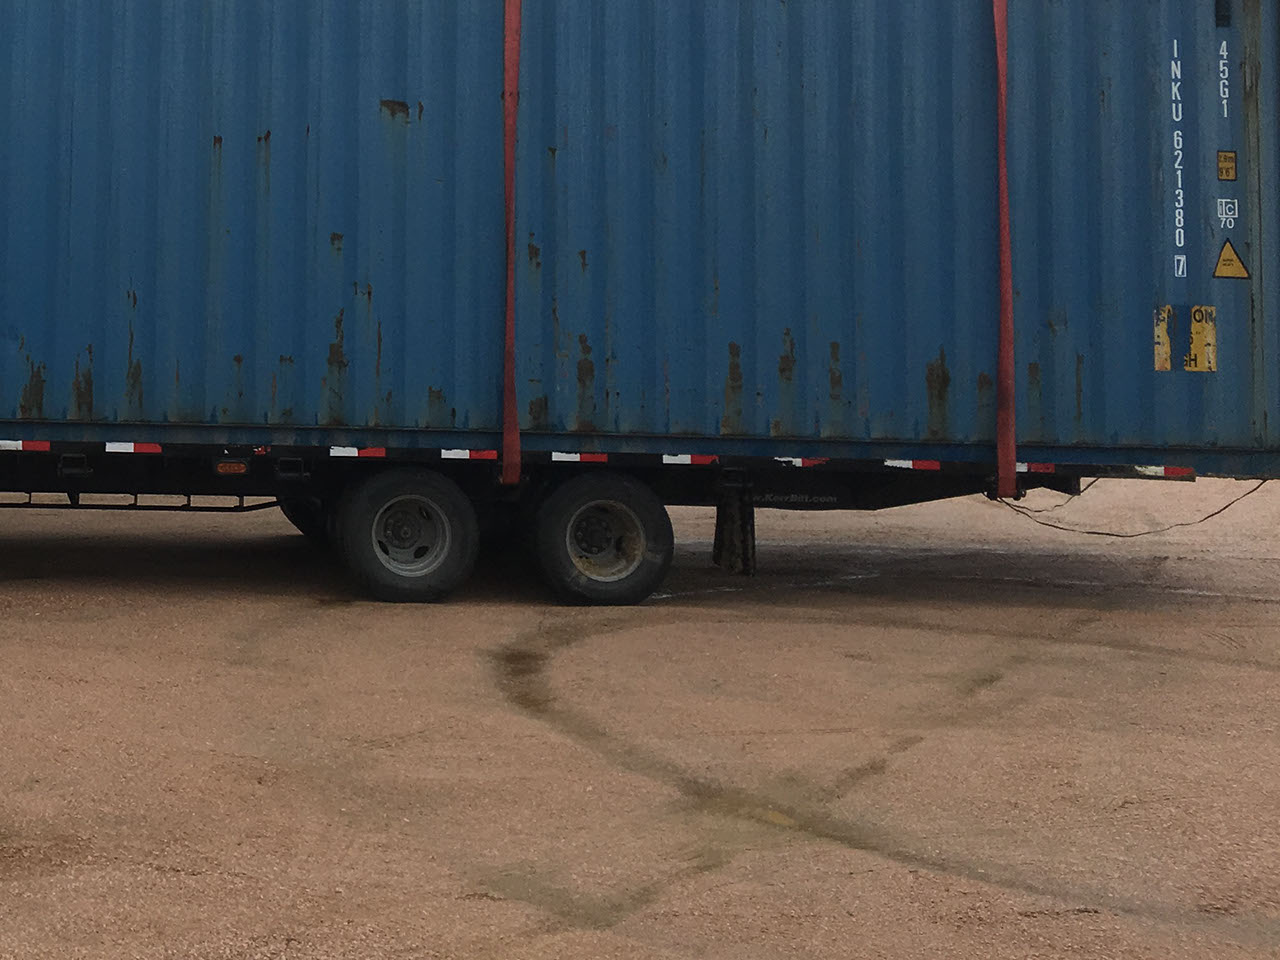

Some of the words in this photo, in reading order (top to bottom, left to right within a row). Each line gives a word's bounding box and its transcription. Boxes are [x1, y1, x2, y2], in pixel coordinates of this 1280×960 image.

[1171, 39, 1183, 122] INKU
[1219, 40, 1229, 118] 45G1
[1173, 130, 1185, 248] 621380
[1220, 218, 1235, 229] 70
[1176, 256, 1185, 276] 7
